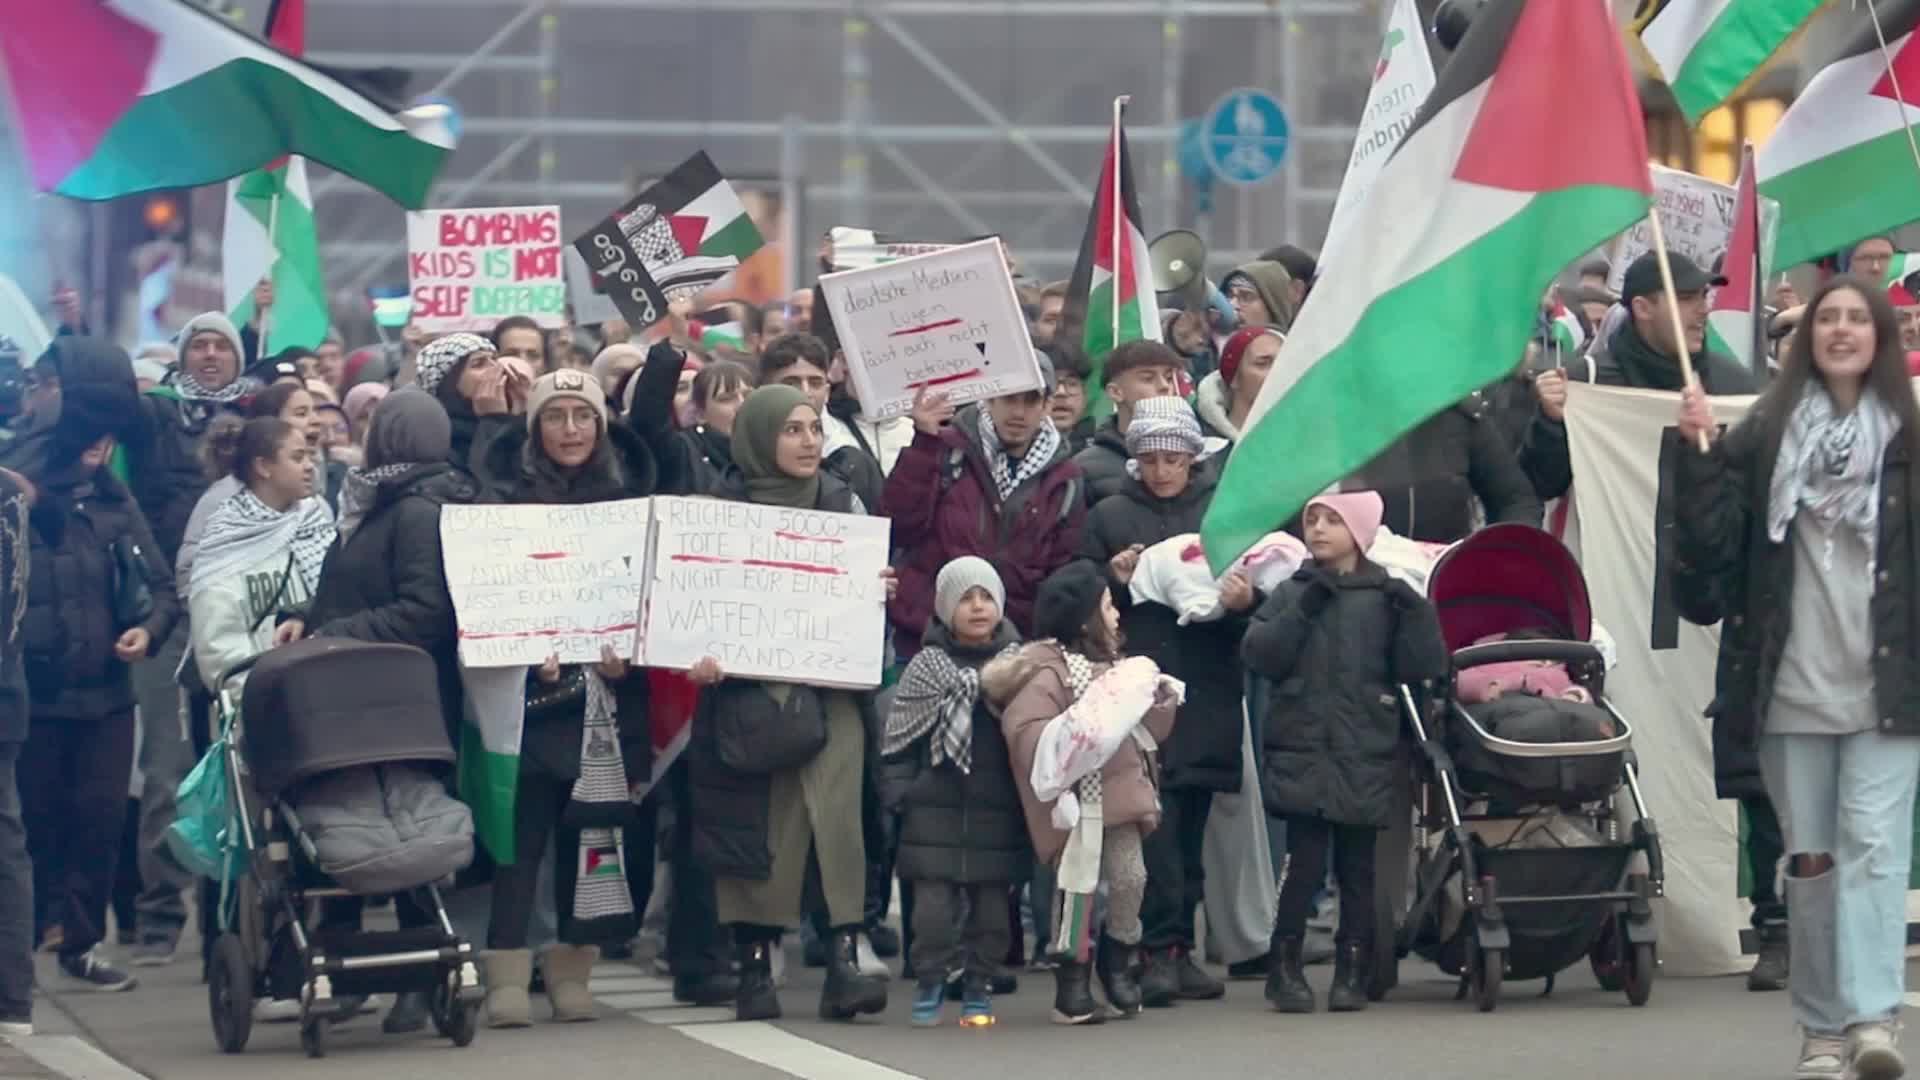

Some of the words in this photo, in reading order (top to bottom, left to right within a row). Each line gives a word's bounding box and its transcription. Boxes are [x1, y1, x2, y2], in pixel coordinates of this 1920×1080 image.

[440, 211, 557, 247] BOMBING
[410, 250, 475, 279] KIDS
[484, 248, 510, 278] IS
[514, 246, 561, 282] NOT
[412, 285, 470, 317] SELF
[669, 500, 763, 529] REICHEN
[675, 532, 730, 557] TOTE
[671, 568, 723, 593] NICHT
[743, 568, 783, 593] FÜR
[792, 574, 865, 601] EINEN
